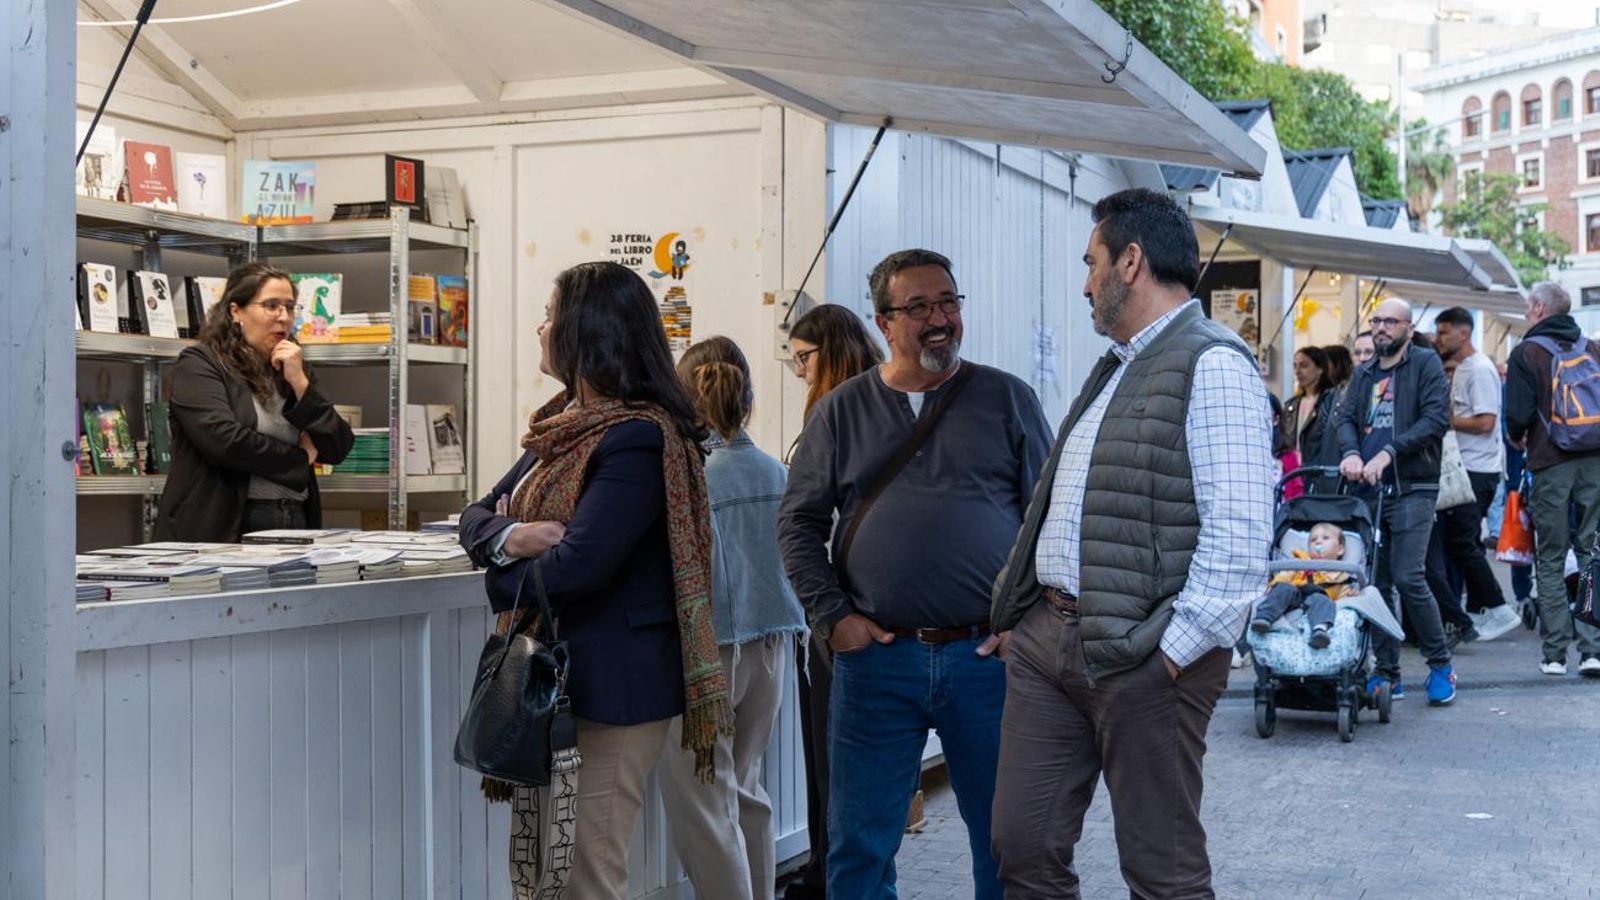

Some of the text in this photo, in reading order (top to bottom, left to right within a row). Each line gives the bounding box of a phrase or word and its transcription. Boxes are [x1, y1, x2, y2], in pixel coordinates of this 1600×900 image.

[260, 172, 299, 192] ZAK
[256, 203, 297, 222] AZUL
[610, 234, 652, 243] 38 FERIA
[624, 246, 652, 254] LIBRO
